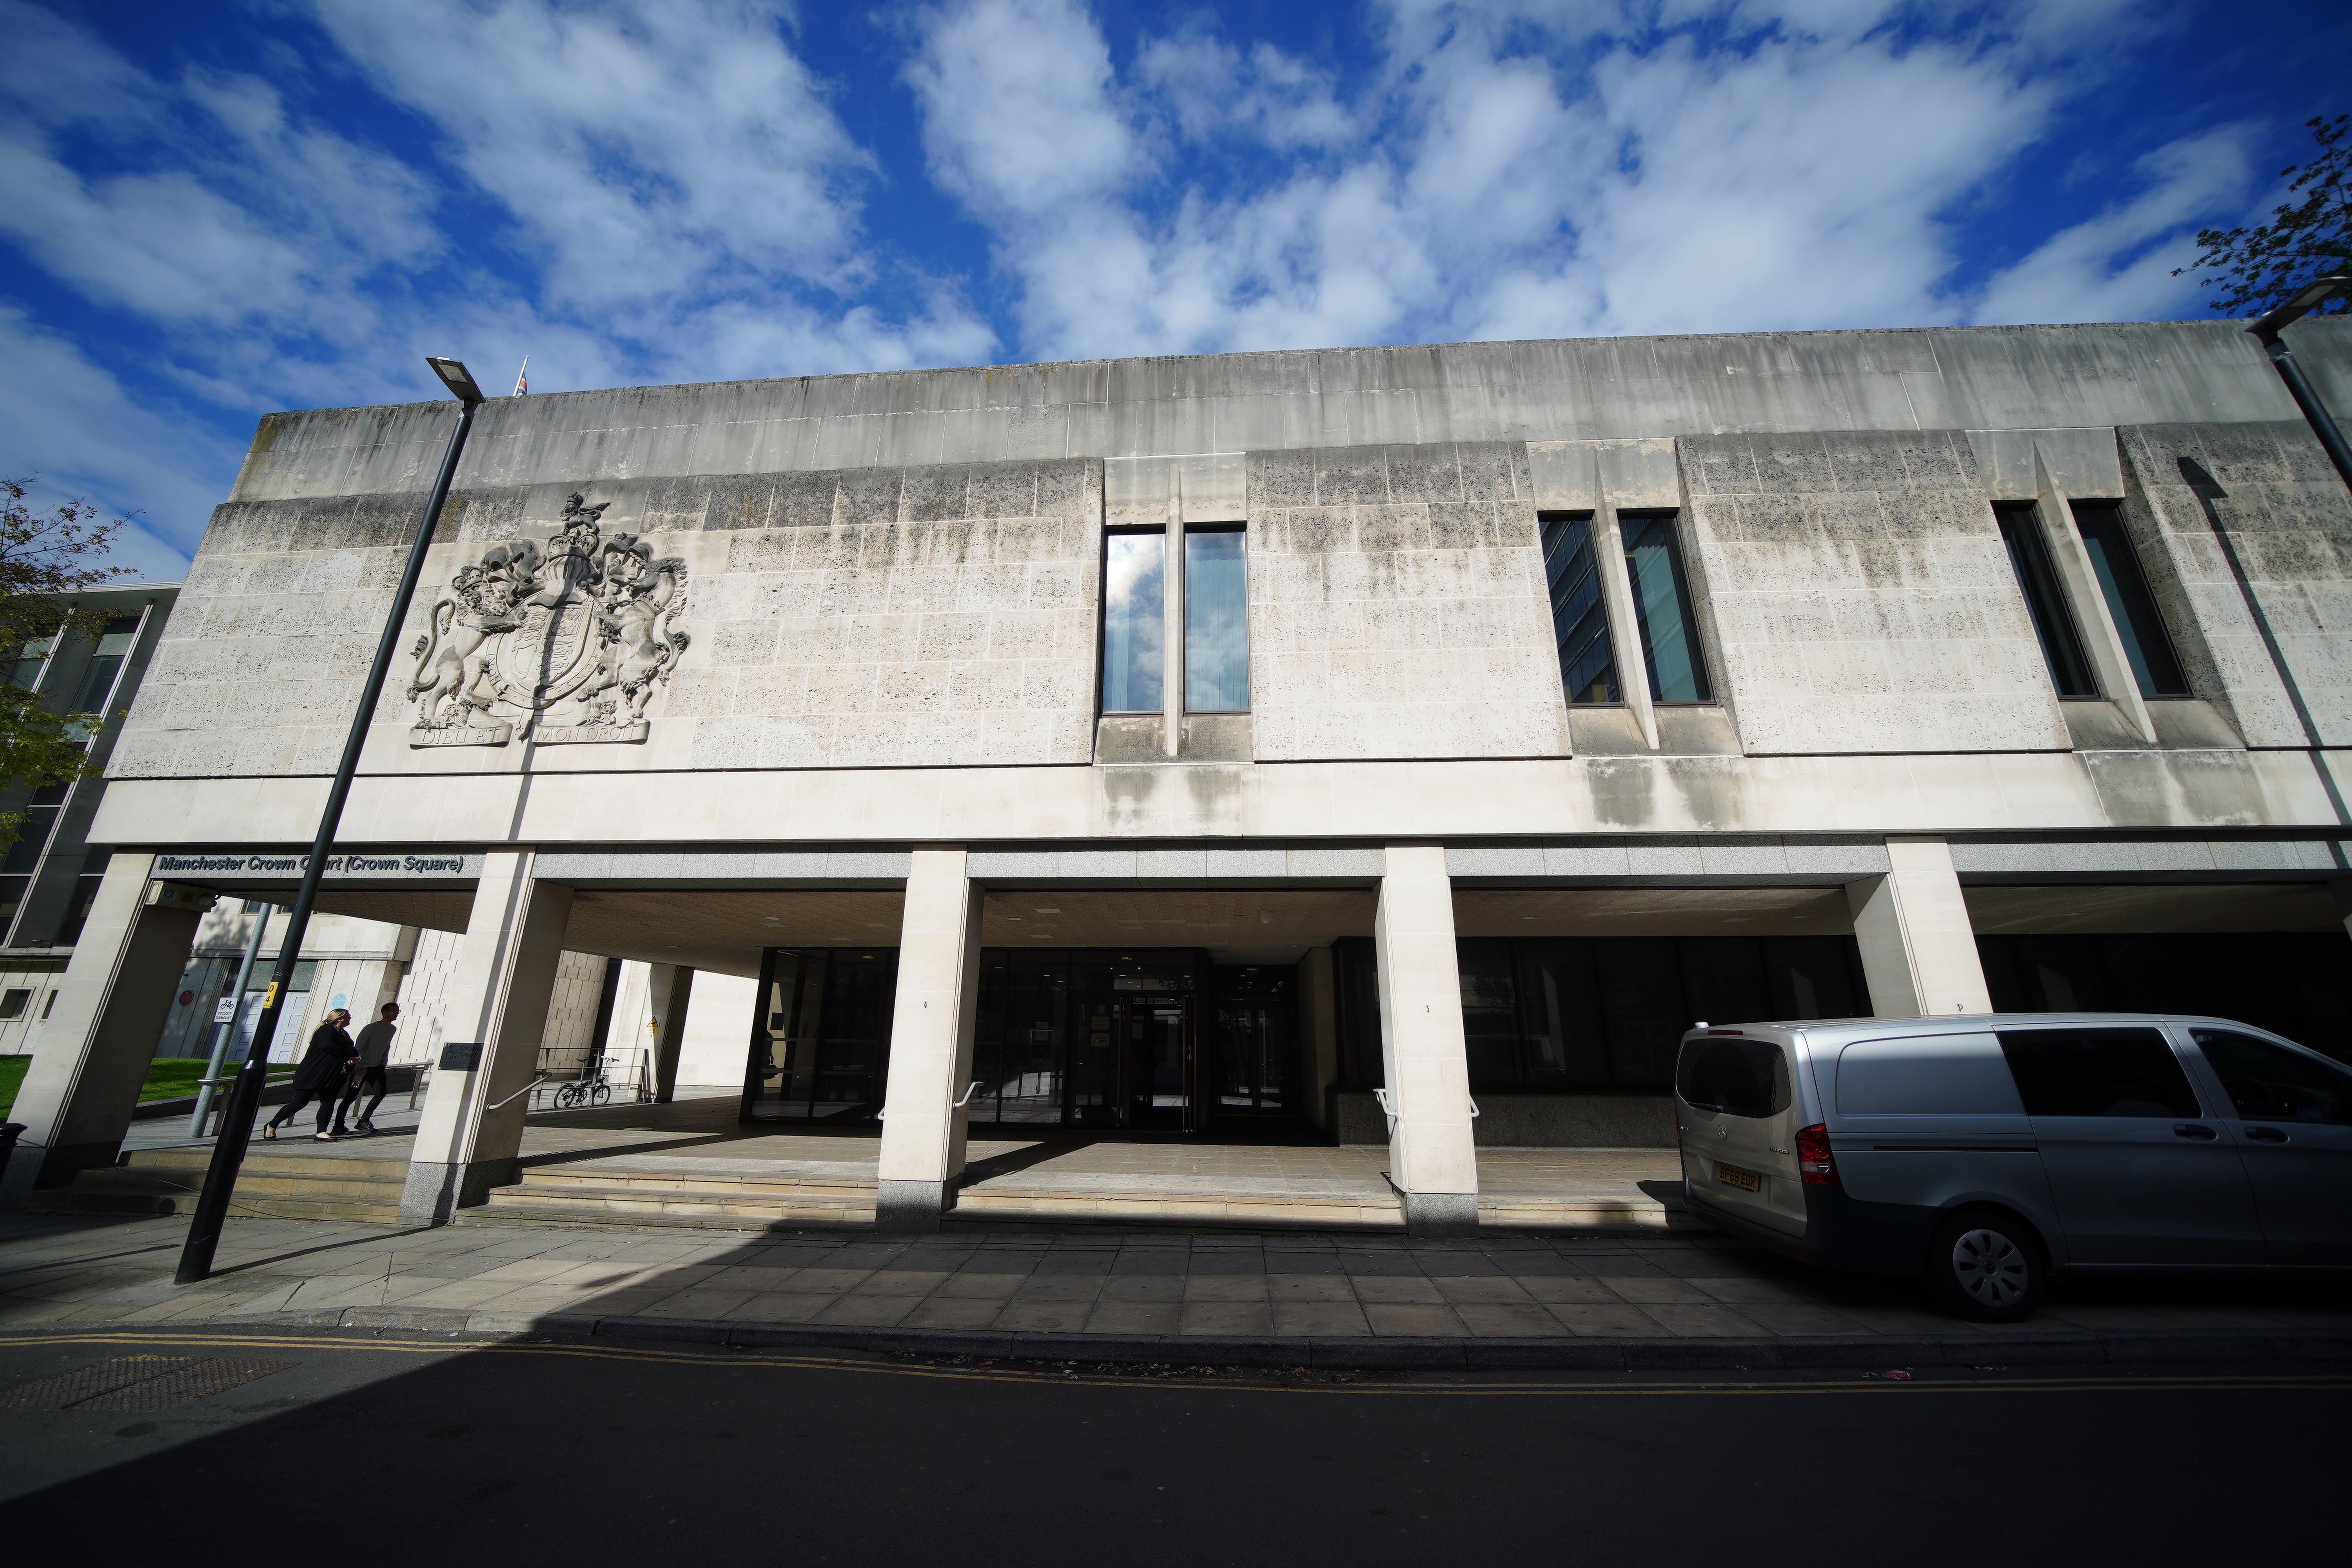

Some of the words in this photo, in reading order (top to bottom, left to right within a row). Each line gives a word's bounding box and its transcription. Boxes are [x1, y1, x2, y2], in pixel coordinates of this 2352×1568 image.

[487, 653, 501, 686] HONI
[420, 730, 468, 744] DIEU
[474, 728, 501, 743] ET
[535, 727, 581, 742] MON
[584, 725, 640, 741] DROIT
[158, 856, 246, 870] Manchester
[247, 856, 296, 870] Crown
[299, 856, 343, 871] Crt
[345, 856, 400, 873] (Crown
[403, 856, 464, 873] Square)
[1720, 1167, 1739, 1183] BF68
[1741, 1172, 1756, 1188] EUR
